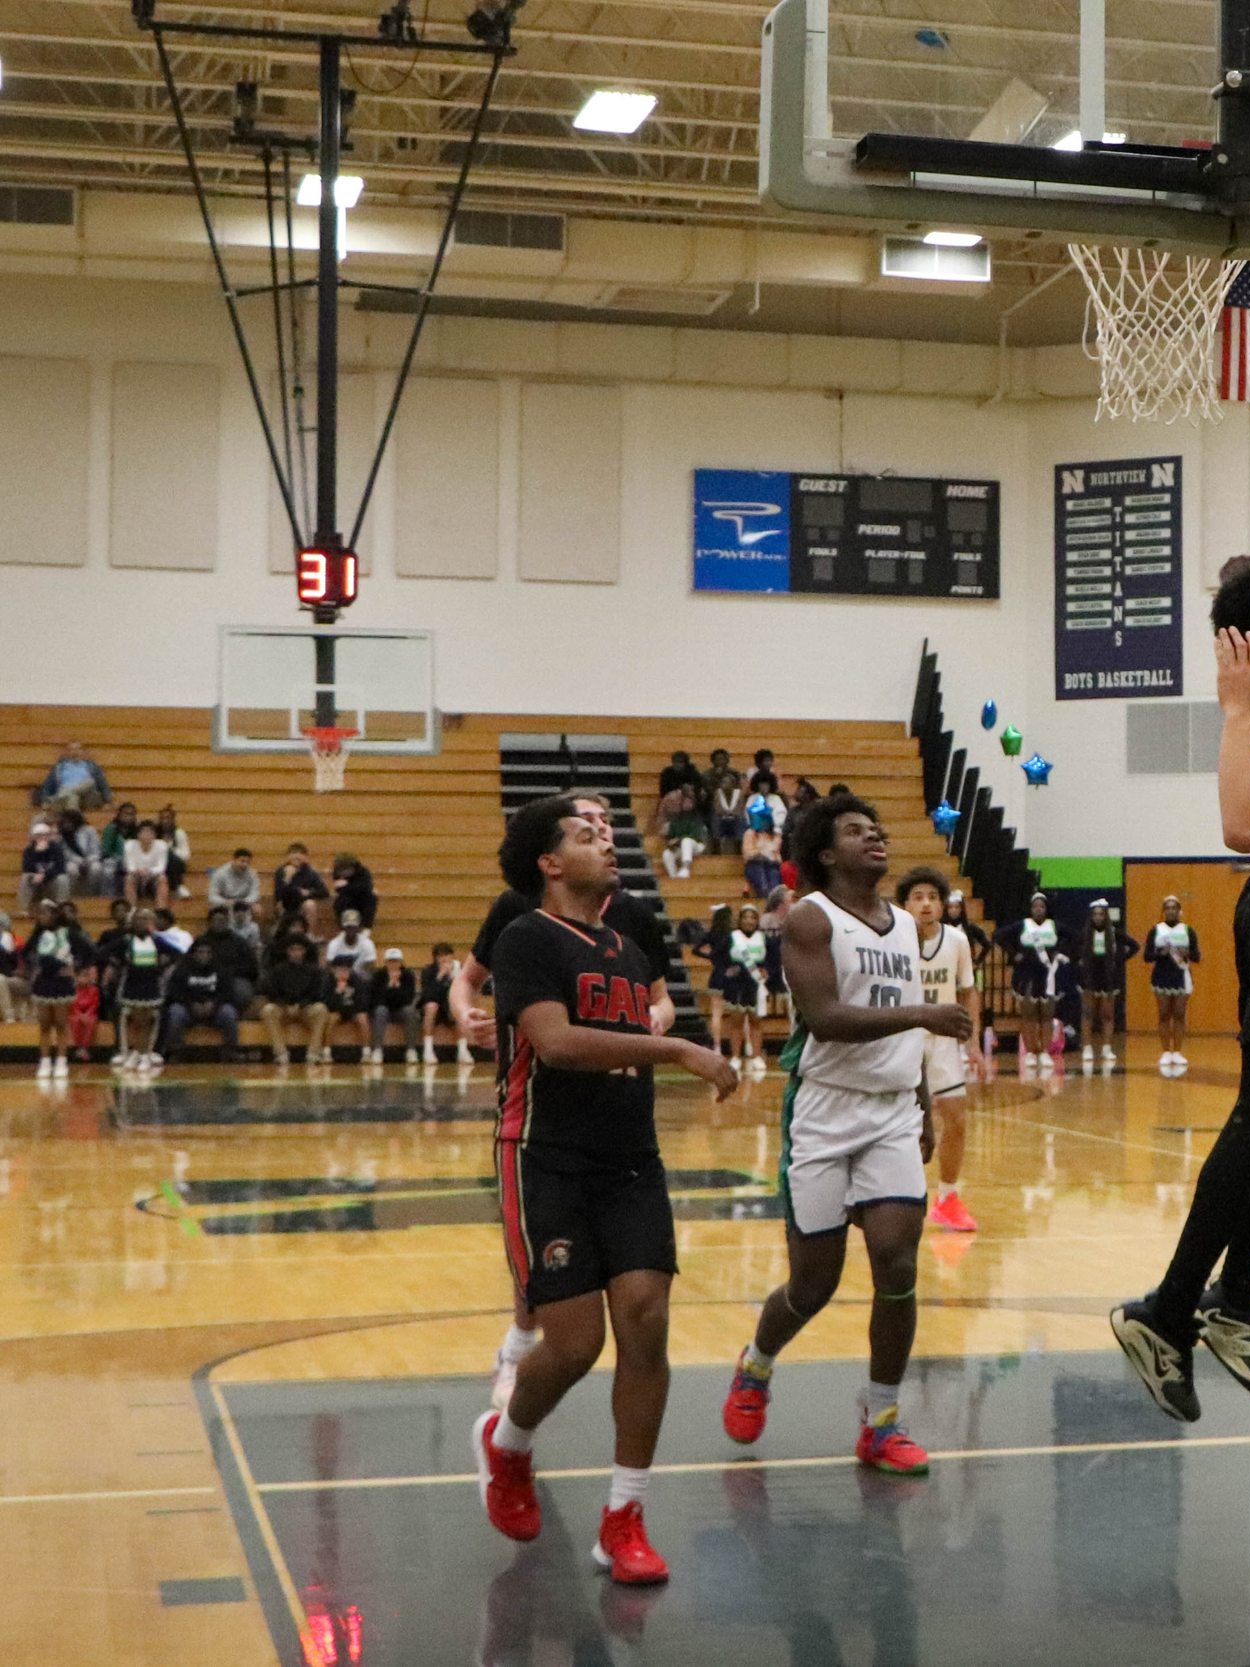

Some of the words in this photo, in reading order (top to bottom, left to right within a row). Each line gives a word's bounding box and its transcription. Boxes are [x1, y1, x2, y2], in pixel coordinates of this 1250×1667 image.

[799, 479, 848, 493] GUEST
[1062, 470, 1085, 493] N
[1091, 470, 1147, 486] NORTHVIEW
[1151, 463, 1175, 487] N
[947, 485, 988, 499] HOME
[858, 524, 901, 536] PERIOD
[300, 552, 356, 598] 31
[1064, 673, 1094, 690] BOYS
[1097, 670, 1174, 688] BASKETBALL
[855, 946, 913, 982] TITANS
